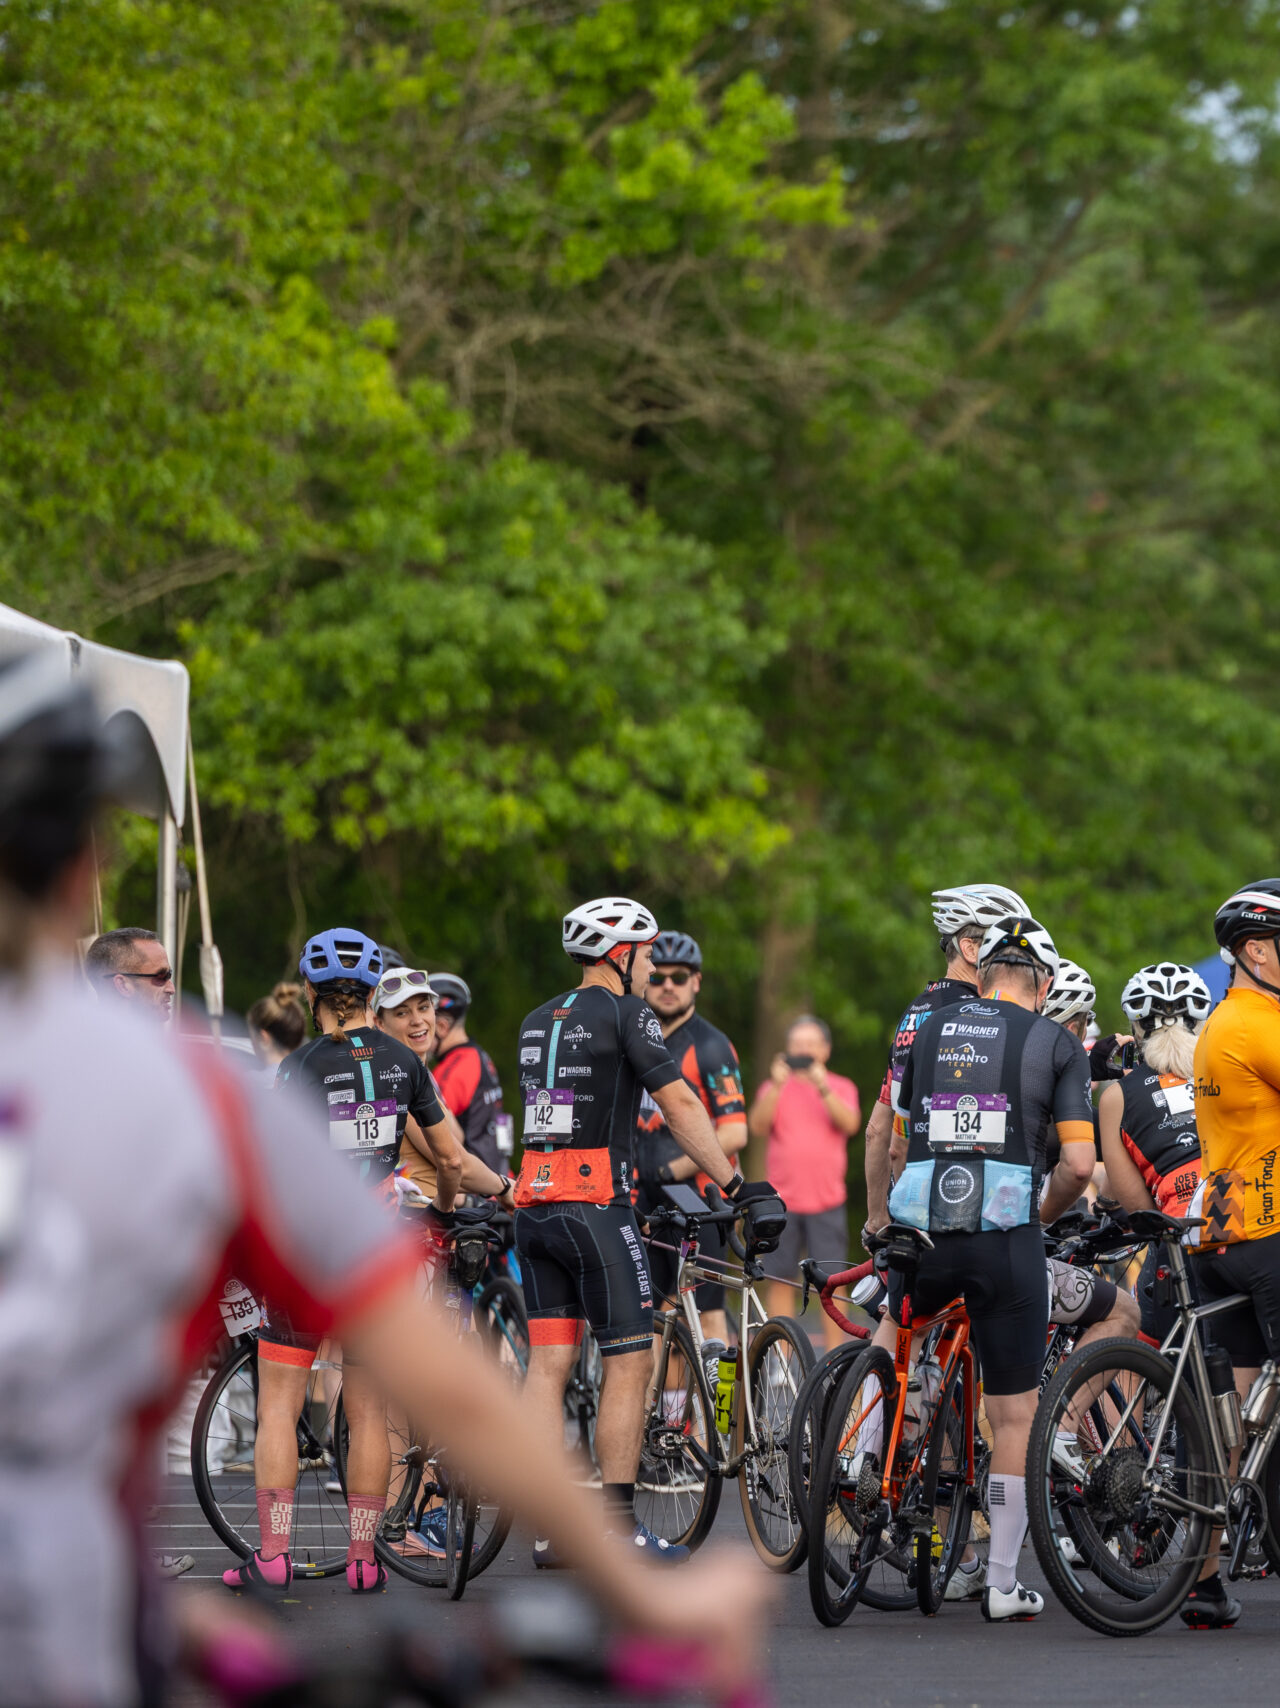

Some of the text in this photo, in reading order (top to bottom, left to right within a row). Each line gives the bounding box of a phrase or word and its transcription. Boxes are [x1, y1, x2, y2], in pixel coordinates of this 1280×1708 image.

[957, 1024, 999, 1036] WAGNER
[937, 1053, 988, 1064] MARANTO
[379, 1072, 408, 1080] MARANTO
[566, 1066, 592, 1074] WAGNER
[534, 1105, 554, 1125] 142
[952, 1111, 982, 1133] 134
[353, 1118, 379, 1140] 113
[1174, 1171, 1198, 1186] JOE'S
[1255, 1150, 1277, 1192] Fondo
[1175, 1182, 1198, 1194] BIKE
[620, 1225, 651, 1296] RIDE FOR FEAST
[227, 1295, 254, 1321] 135
[897, 1334, 907, 1366] BMC
